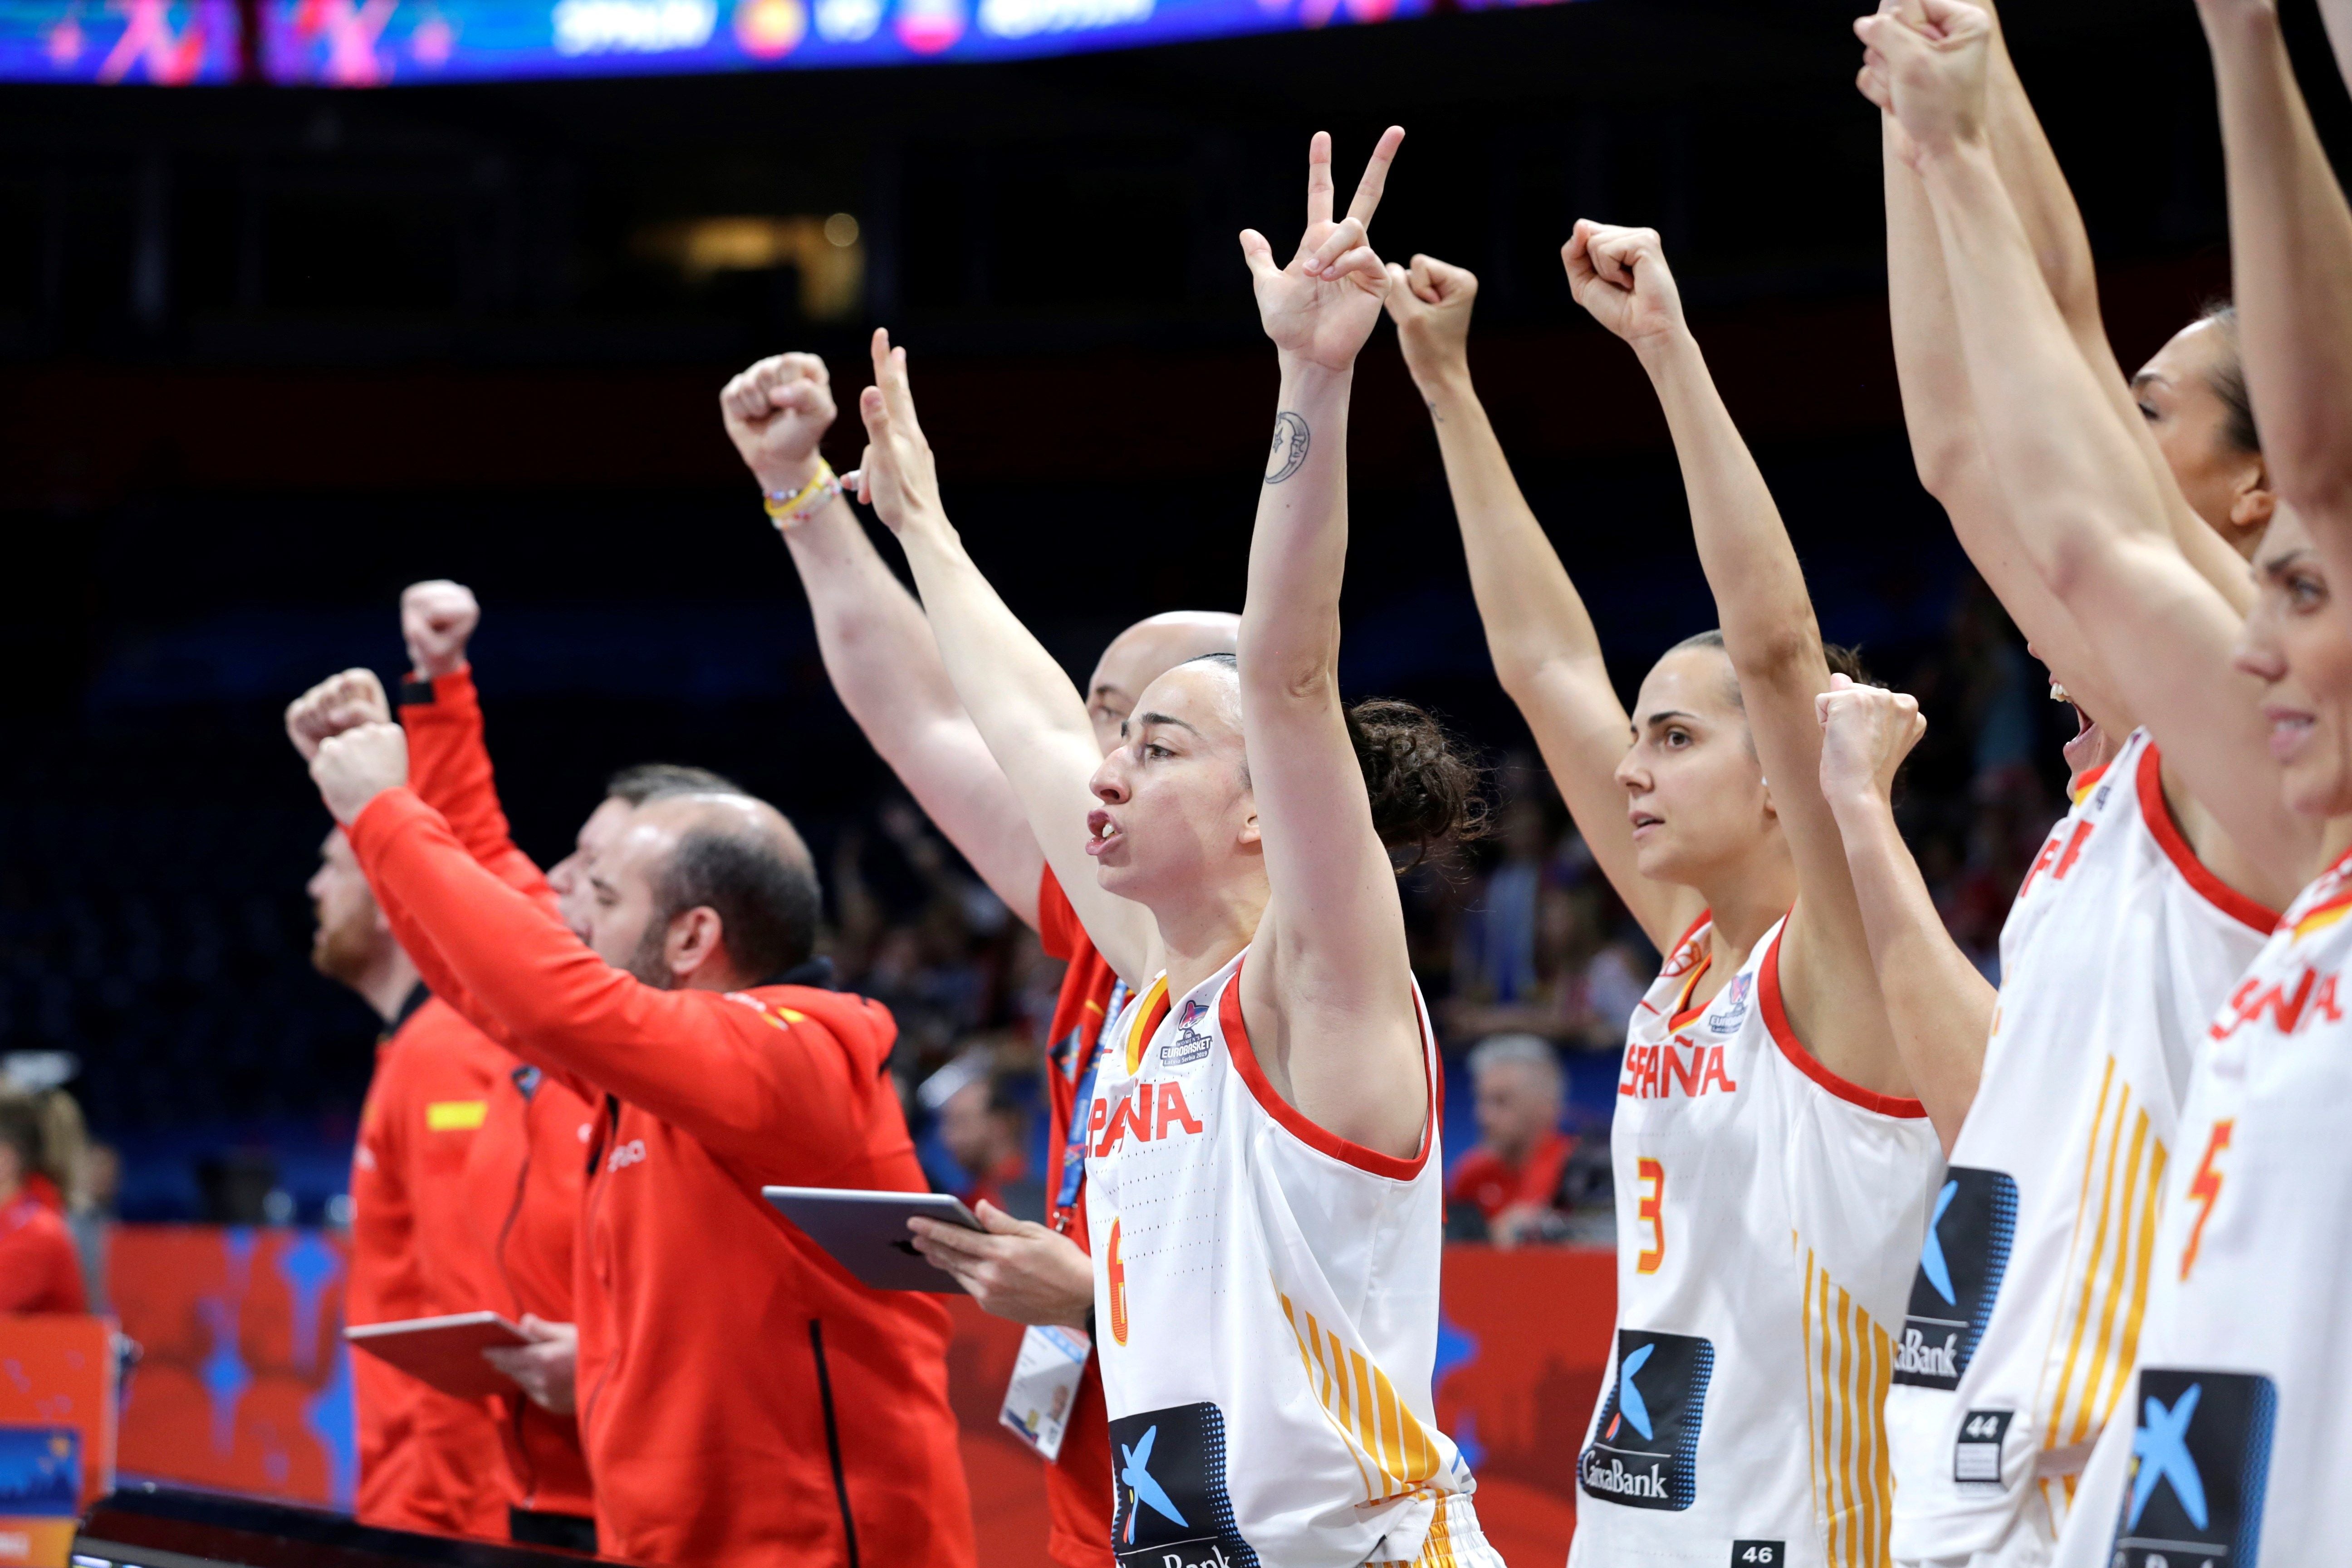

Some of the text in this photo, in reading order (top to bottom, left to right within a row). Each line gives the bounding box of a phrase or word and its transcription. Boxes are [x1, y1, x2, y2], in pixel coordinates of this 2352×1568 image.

[1162, 1038, 1210, 1058] EUROBASKET
[1177, 1035, 1200, 1046] WOMEN'S
[1181, 1054, 1196, 1063] Serbia
[1636, 1157, 1665, 1275] 3
[1894, 1328, 1958, 1378] aBank
[1965, 1415, 1999, 1439] 44
[1582, 1450, 1669, 1499] CaixaBank
[1742, 1546, 1773, 1564] 46
